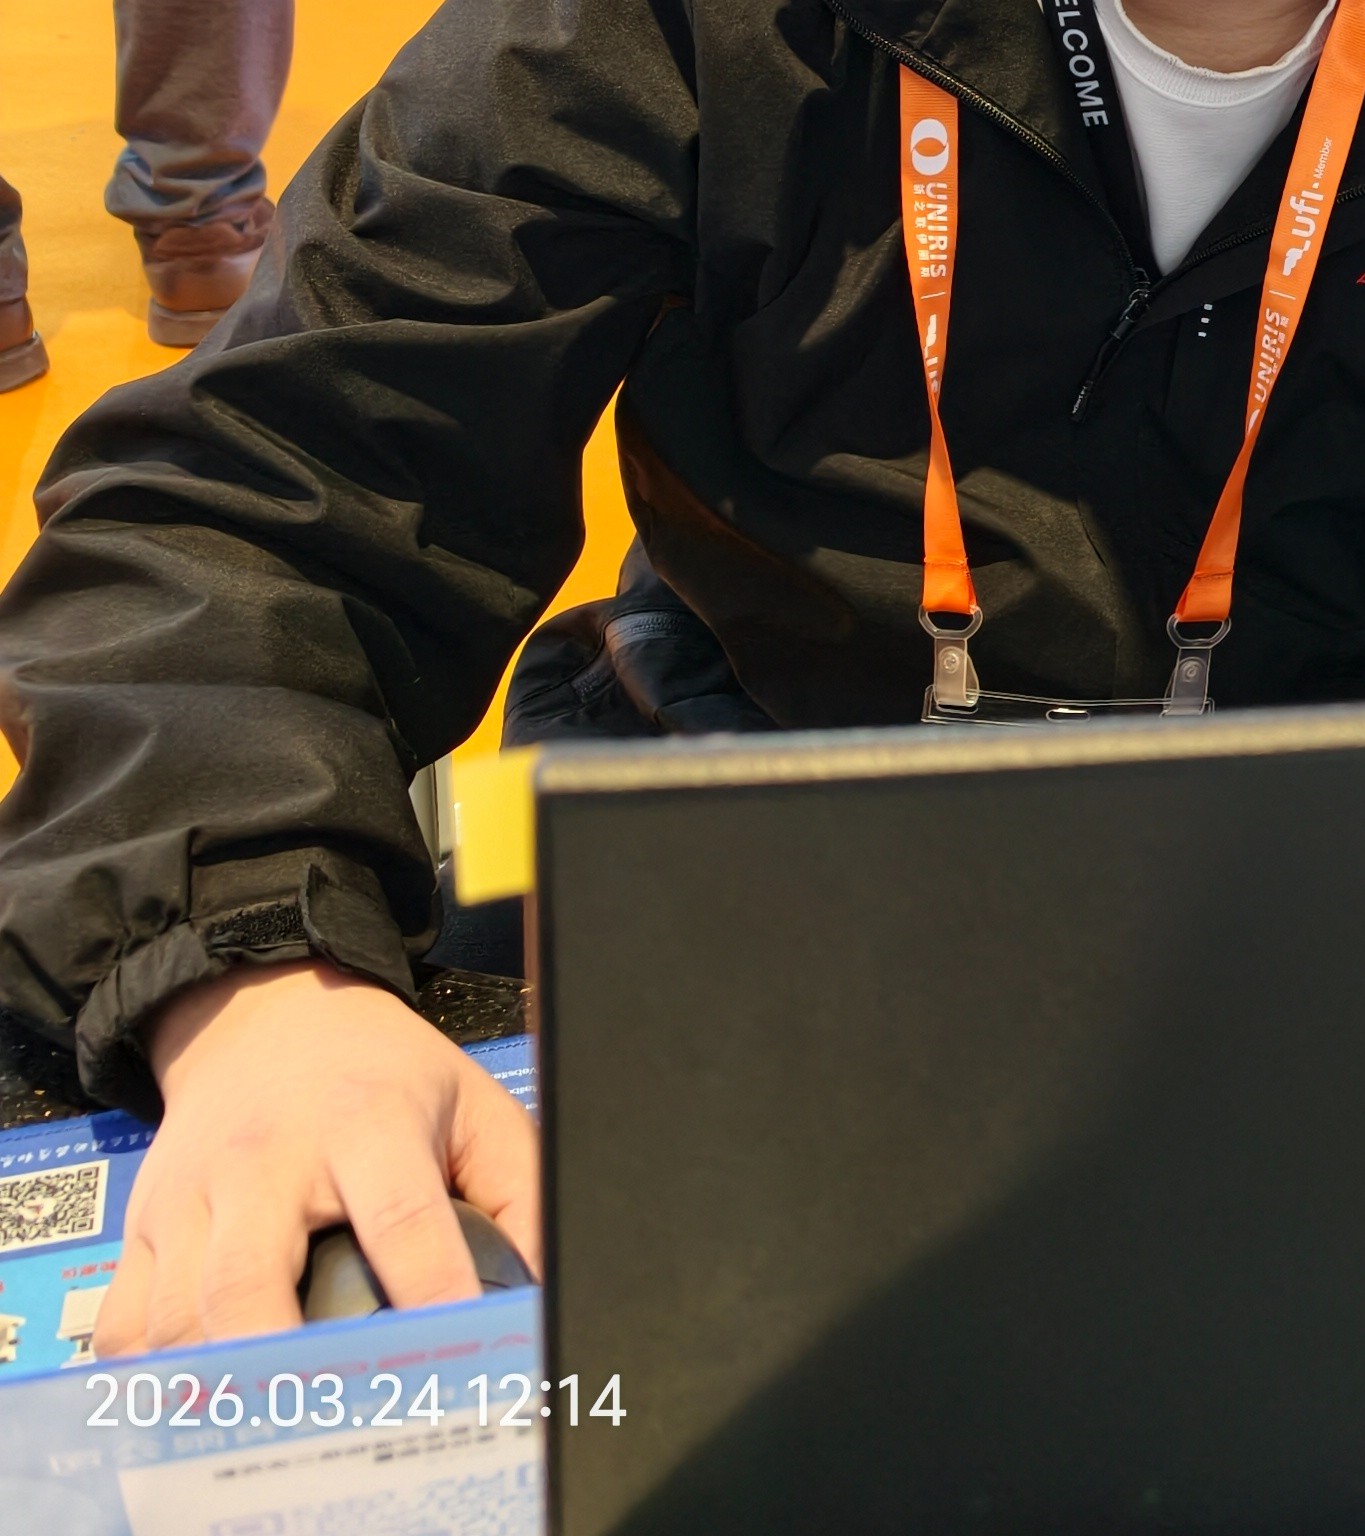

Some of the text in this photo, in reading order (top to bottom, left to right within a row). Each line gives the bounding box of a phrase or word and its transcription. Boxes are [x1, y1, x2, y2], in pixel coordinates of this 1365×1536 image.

[1313, 137, 1333, 180] Member
[926, 182, 948, 277] UNIRIS
[1254, 307, 1280, 403] UNIRIS
